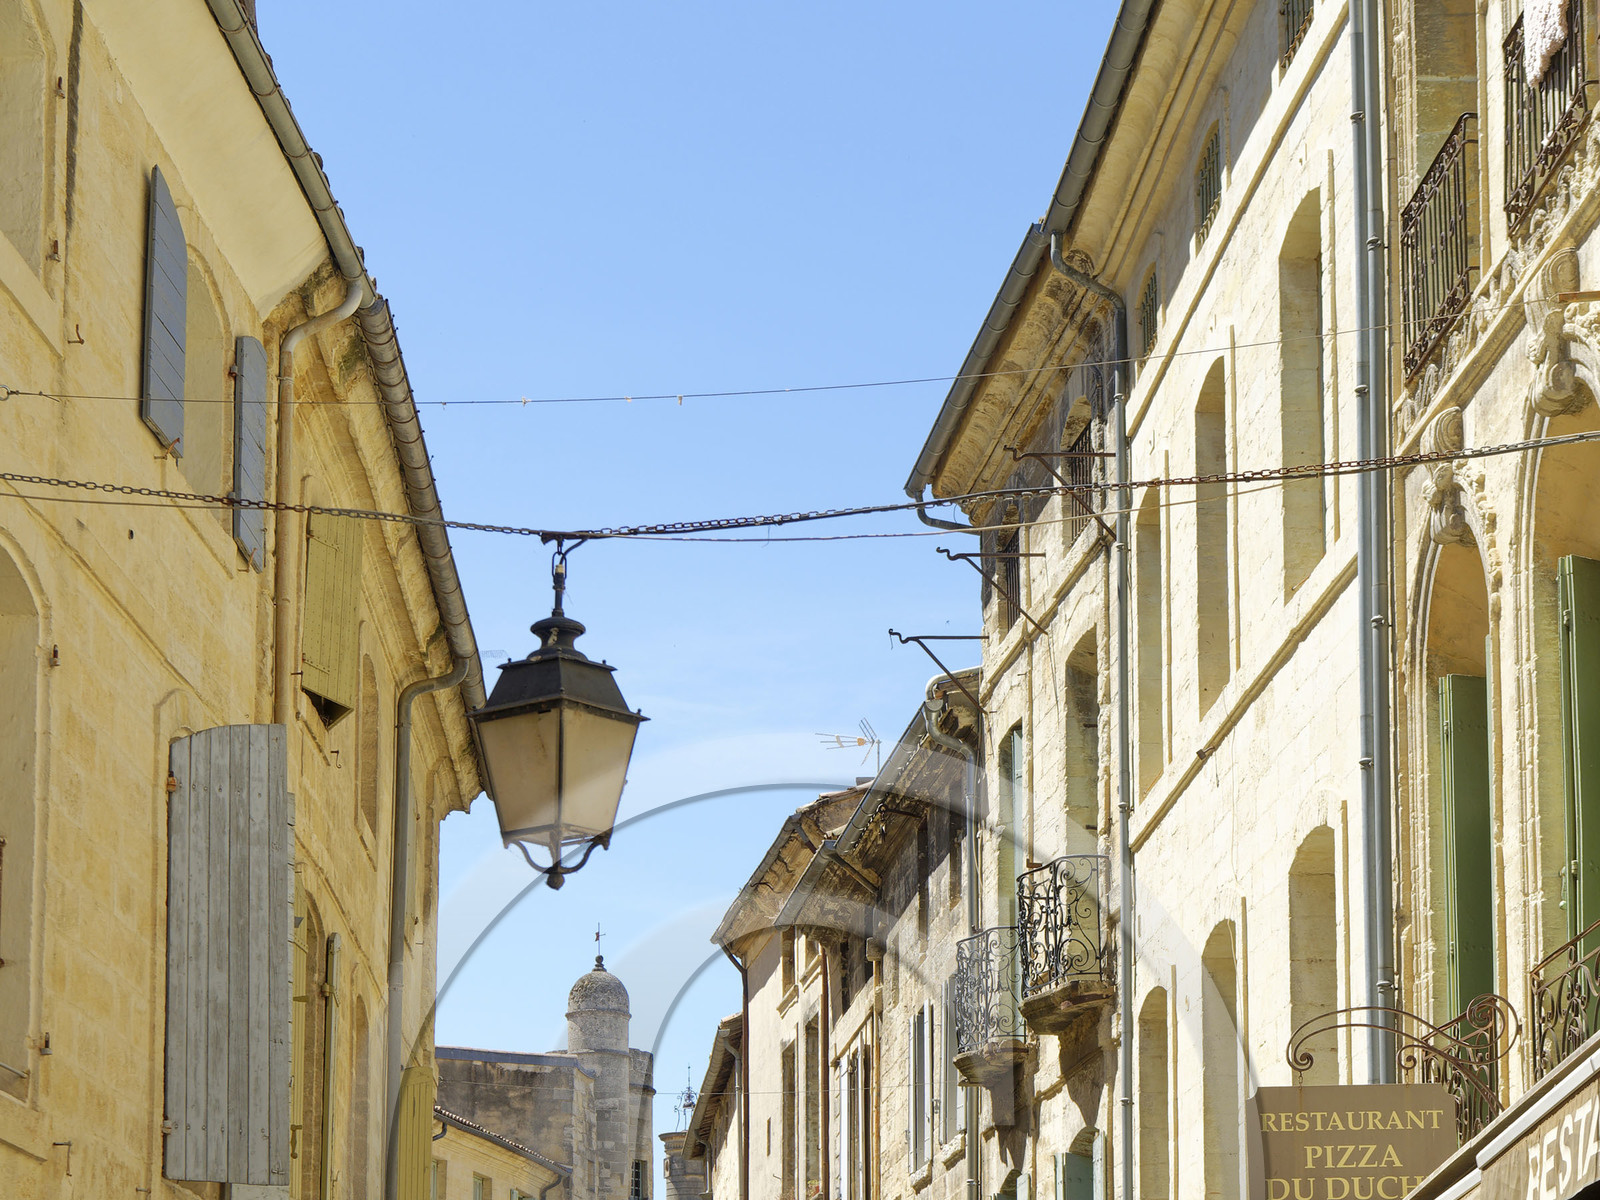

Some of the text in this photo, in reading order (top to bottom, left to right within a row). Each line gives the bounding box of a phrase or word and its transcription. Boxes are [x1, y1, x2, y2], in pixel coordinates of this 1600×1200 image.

[1260, 1109, 1444, 1132] RESTAURANT
[1303, 1143, 1404, 1169] PIZZA
[1324, 1175, 1431, 1200] DUCH
